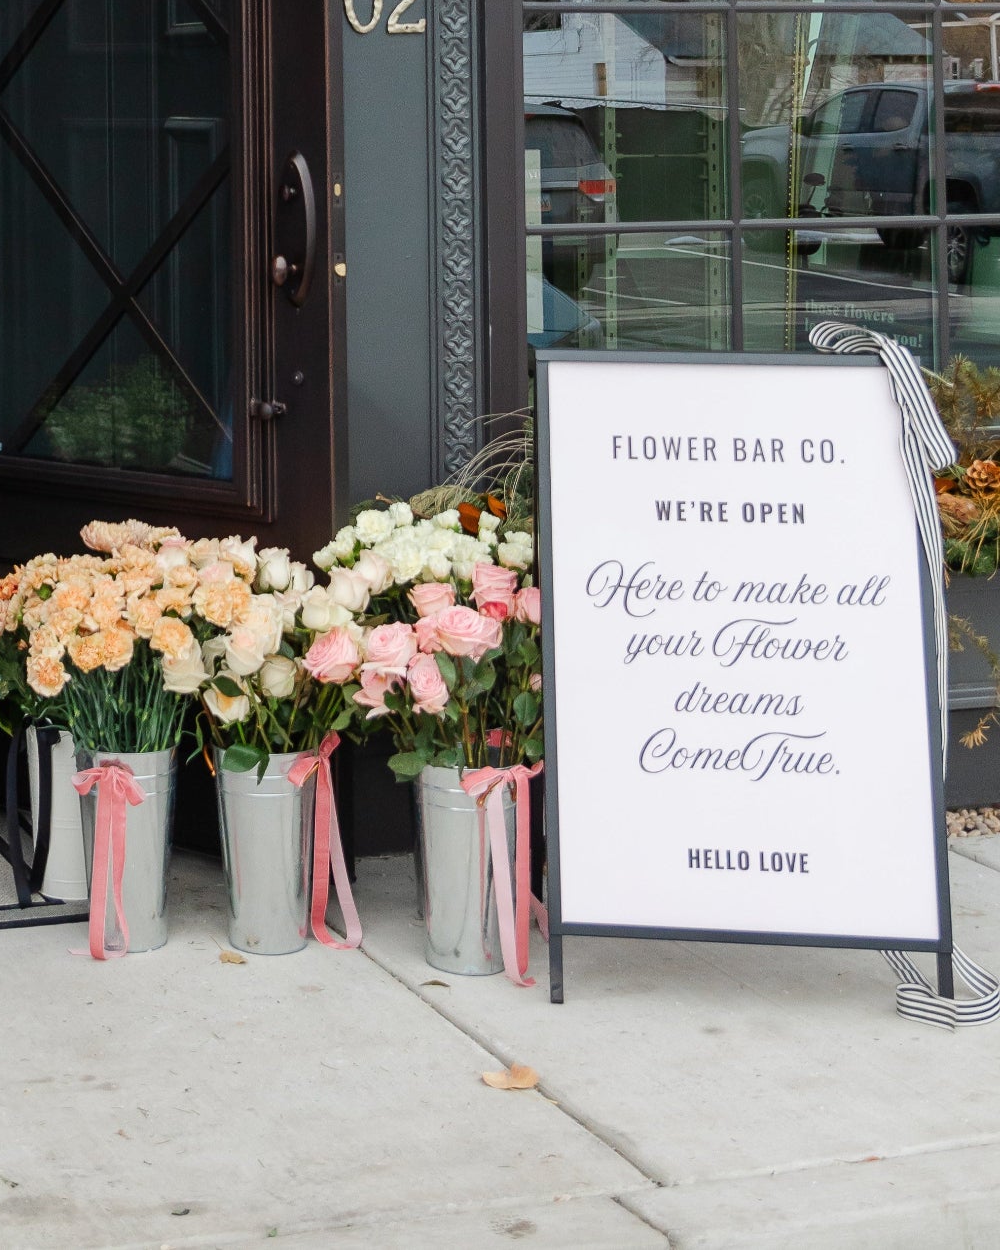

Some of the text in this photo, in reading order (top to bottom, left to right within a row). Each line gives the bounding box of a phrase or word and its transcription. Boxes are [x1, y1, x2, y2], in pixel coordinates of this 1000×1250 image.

[844, 302, 895, 323] flowers
[612, 435, 845, 464] FLOWER BAR CO.
[741, 501, 805, 525] OPEN
[585, 559, 891, 618] Here to make all
[623, 617, 849, 668] your Flower
[674, 681, 804, 716] dreams
[638, 727, 840, 782] Come True.
[687, 847, 810, 874] HELLO LOVE
